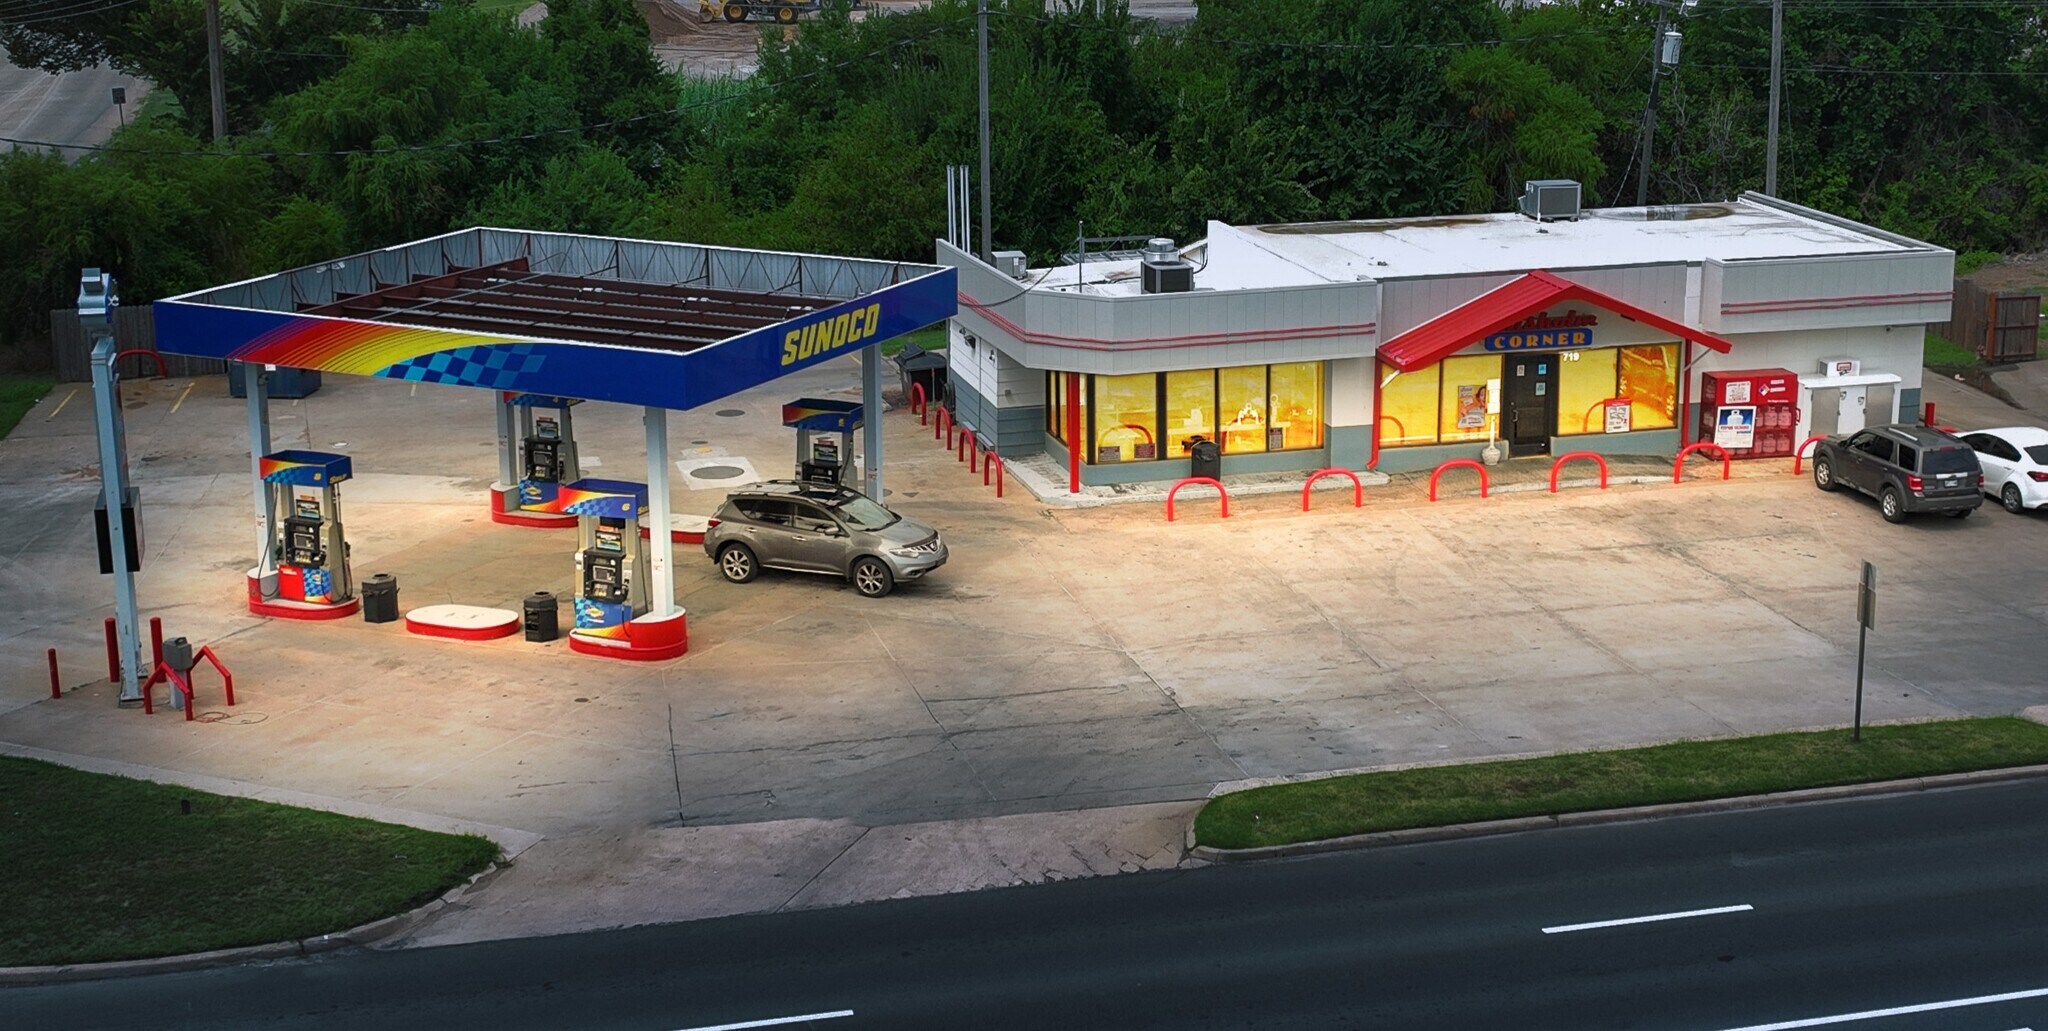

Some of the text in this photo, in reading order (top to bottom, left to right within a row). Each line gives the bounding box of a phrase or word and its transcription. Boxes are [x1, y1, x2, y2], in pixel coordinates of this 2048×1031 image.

[780, 303, 881, 367] SUNOCO
[1493, 332, 1586, 349] CORNER
[1562, 352, 1580, 362] 719
